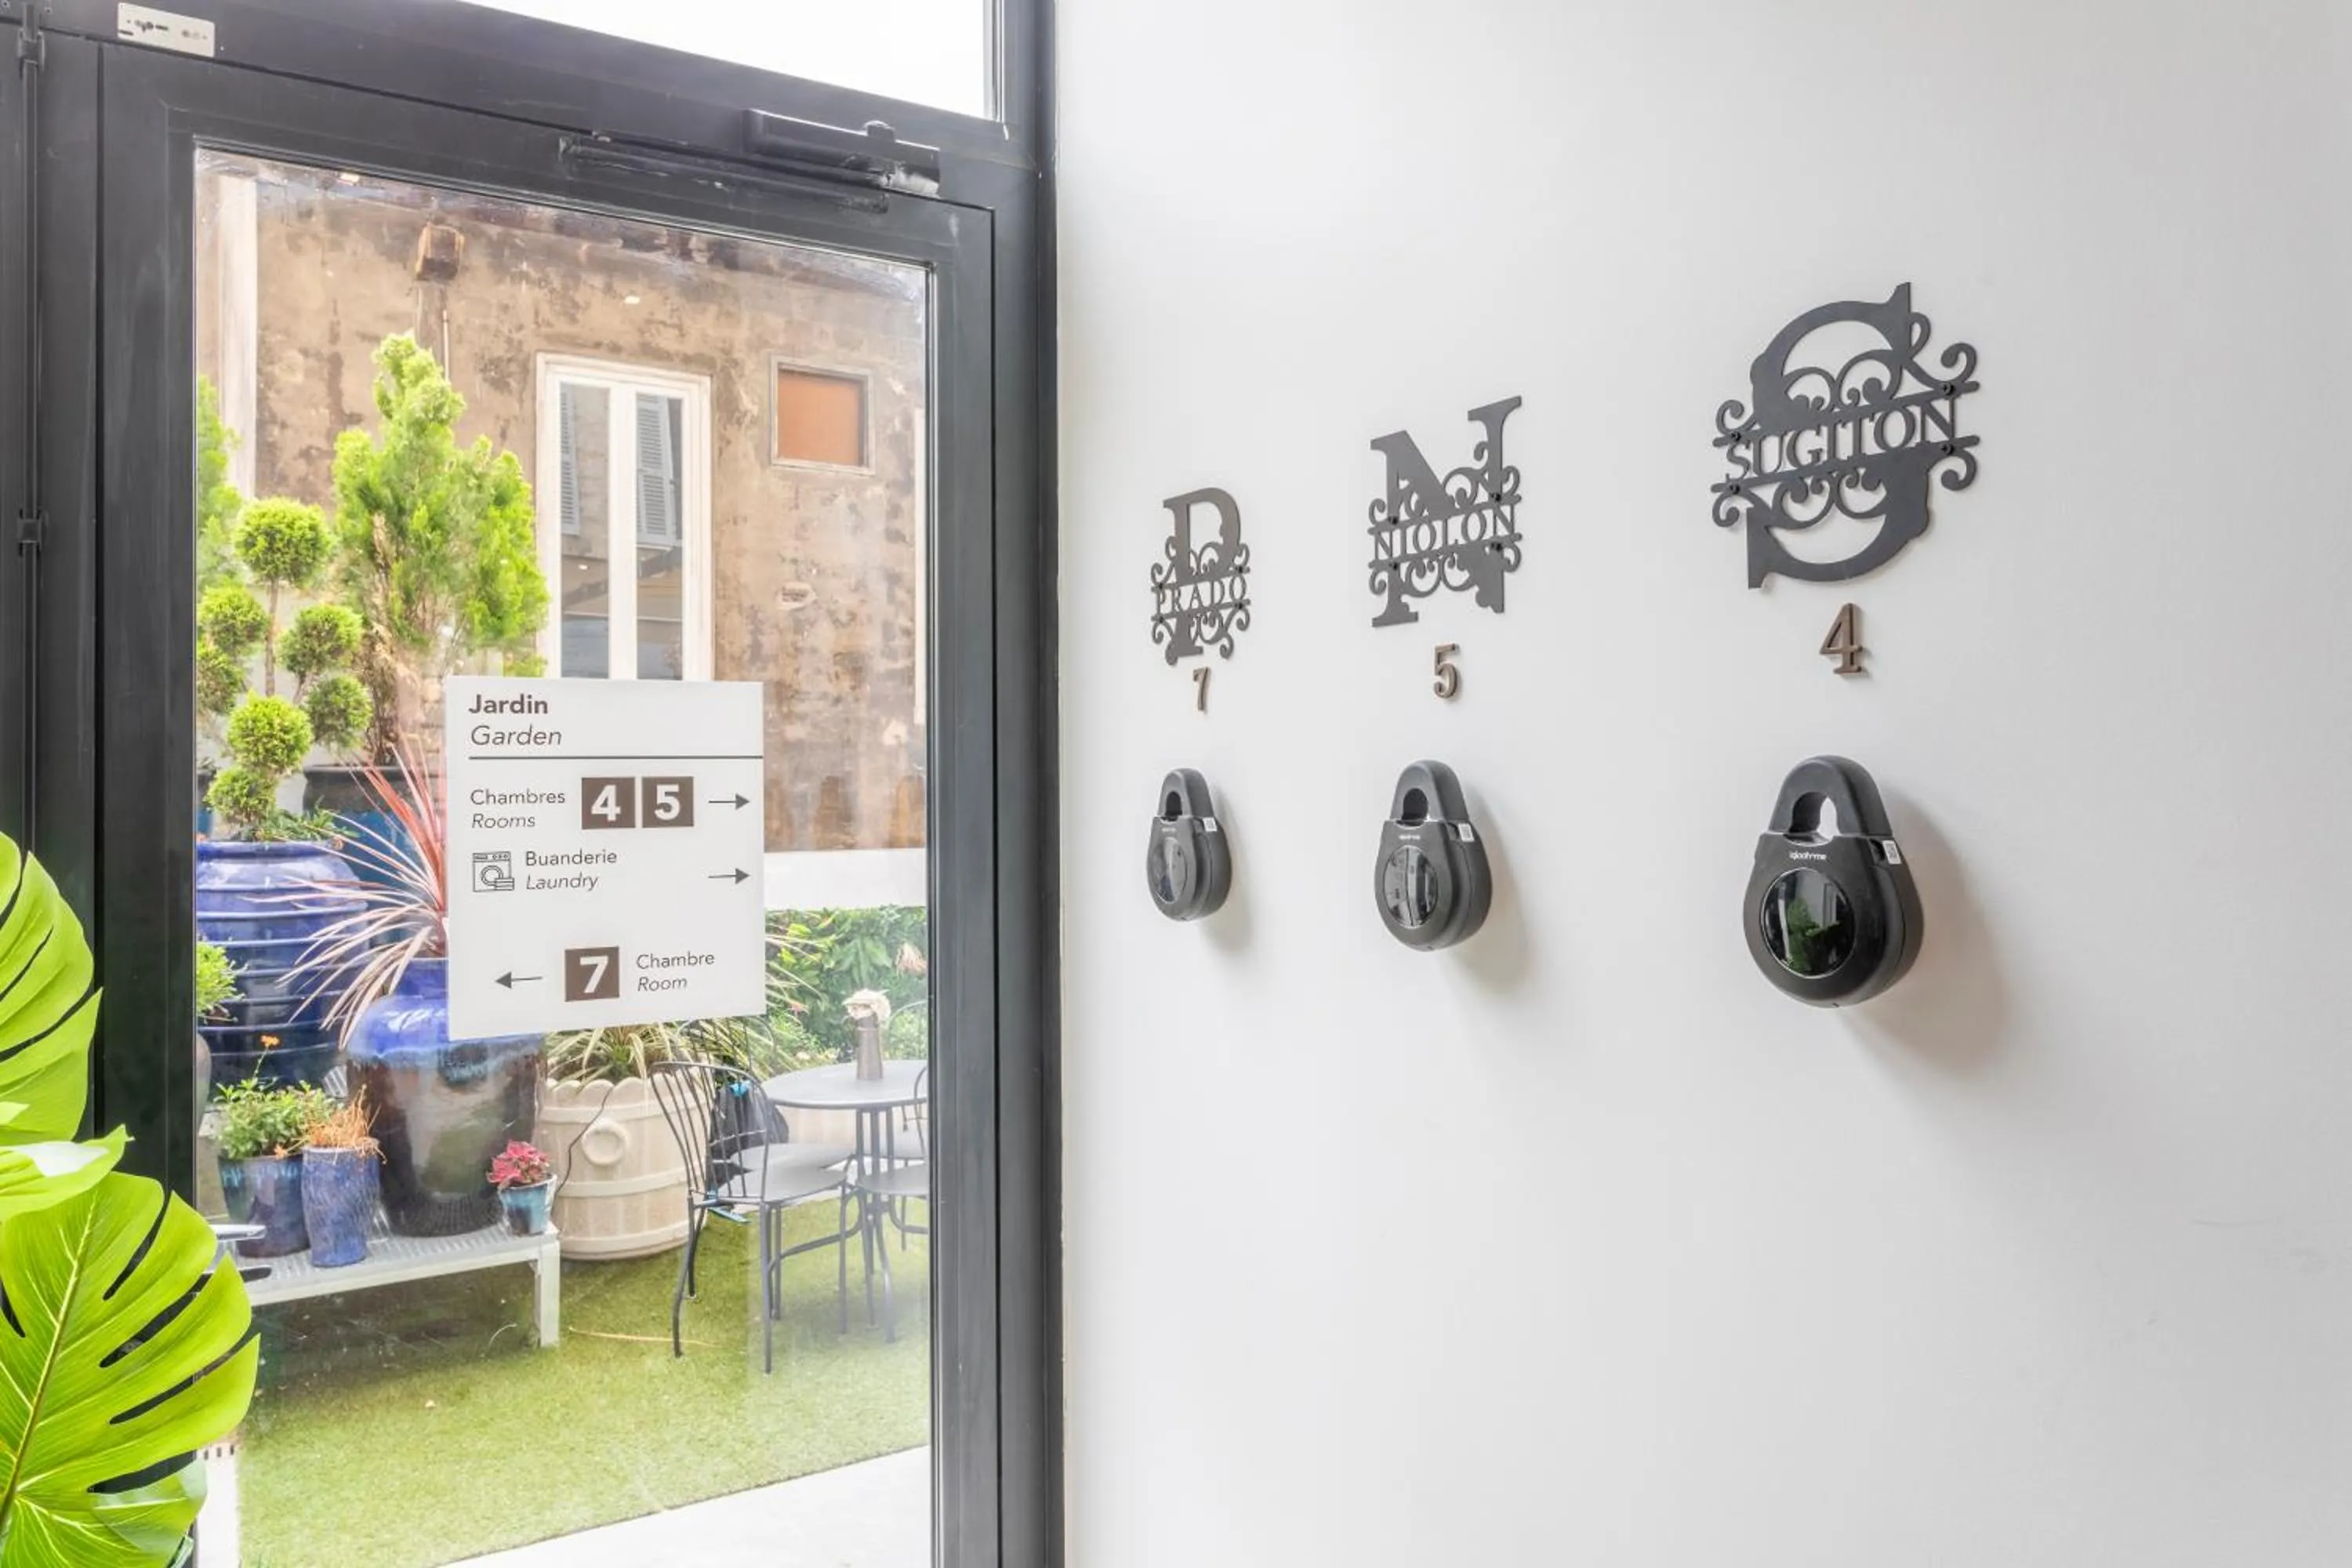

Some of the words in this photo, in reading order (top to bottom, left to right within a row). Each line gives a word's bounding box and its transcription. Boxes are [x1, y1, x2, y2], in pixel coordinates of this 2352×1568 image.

[1726, 397, 1957, 481] SUGITON
[1374, 503, 1515, 563] NIOLON
[1156, 573, 1247, 620] PRADO
[1819, 602, 1863, 675] 4
[1192, 666, 1211, 712] 7
[1433, 643, 1459, 699] 5
[469, 694, 549, 715] Jardin
[471, 723, 563, 746] Garden
[470, 788, 566, 805] Chambres
[591, 785, 621, 822] 4
[654, 784, 681, 820] 5
[471, 813, 536, 829] Rooms
[525, 848, 618, 866] Buanderie
[526, 872, 599, 892] Laundry
[579, 955, 610, 994] 7
[636, 951, 716, 971] Chambre
[637, 976, 688, 993] Room
